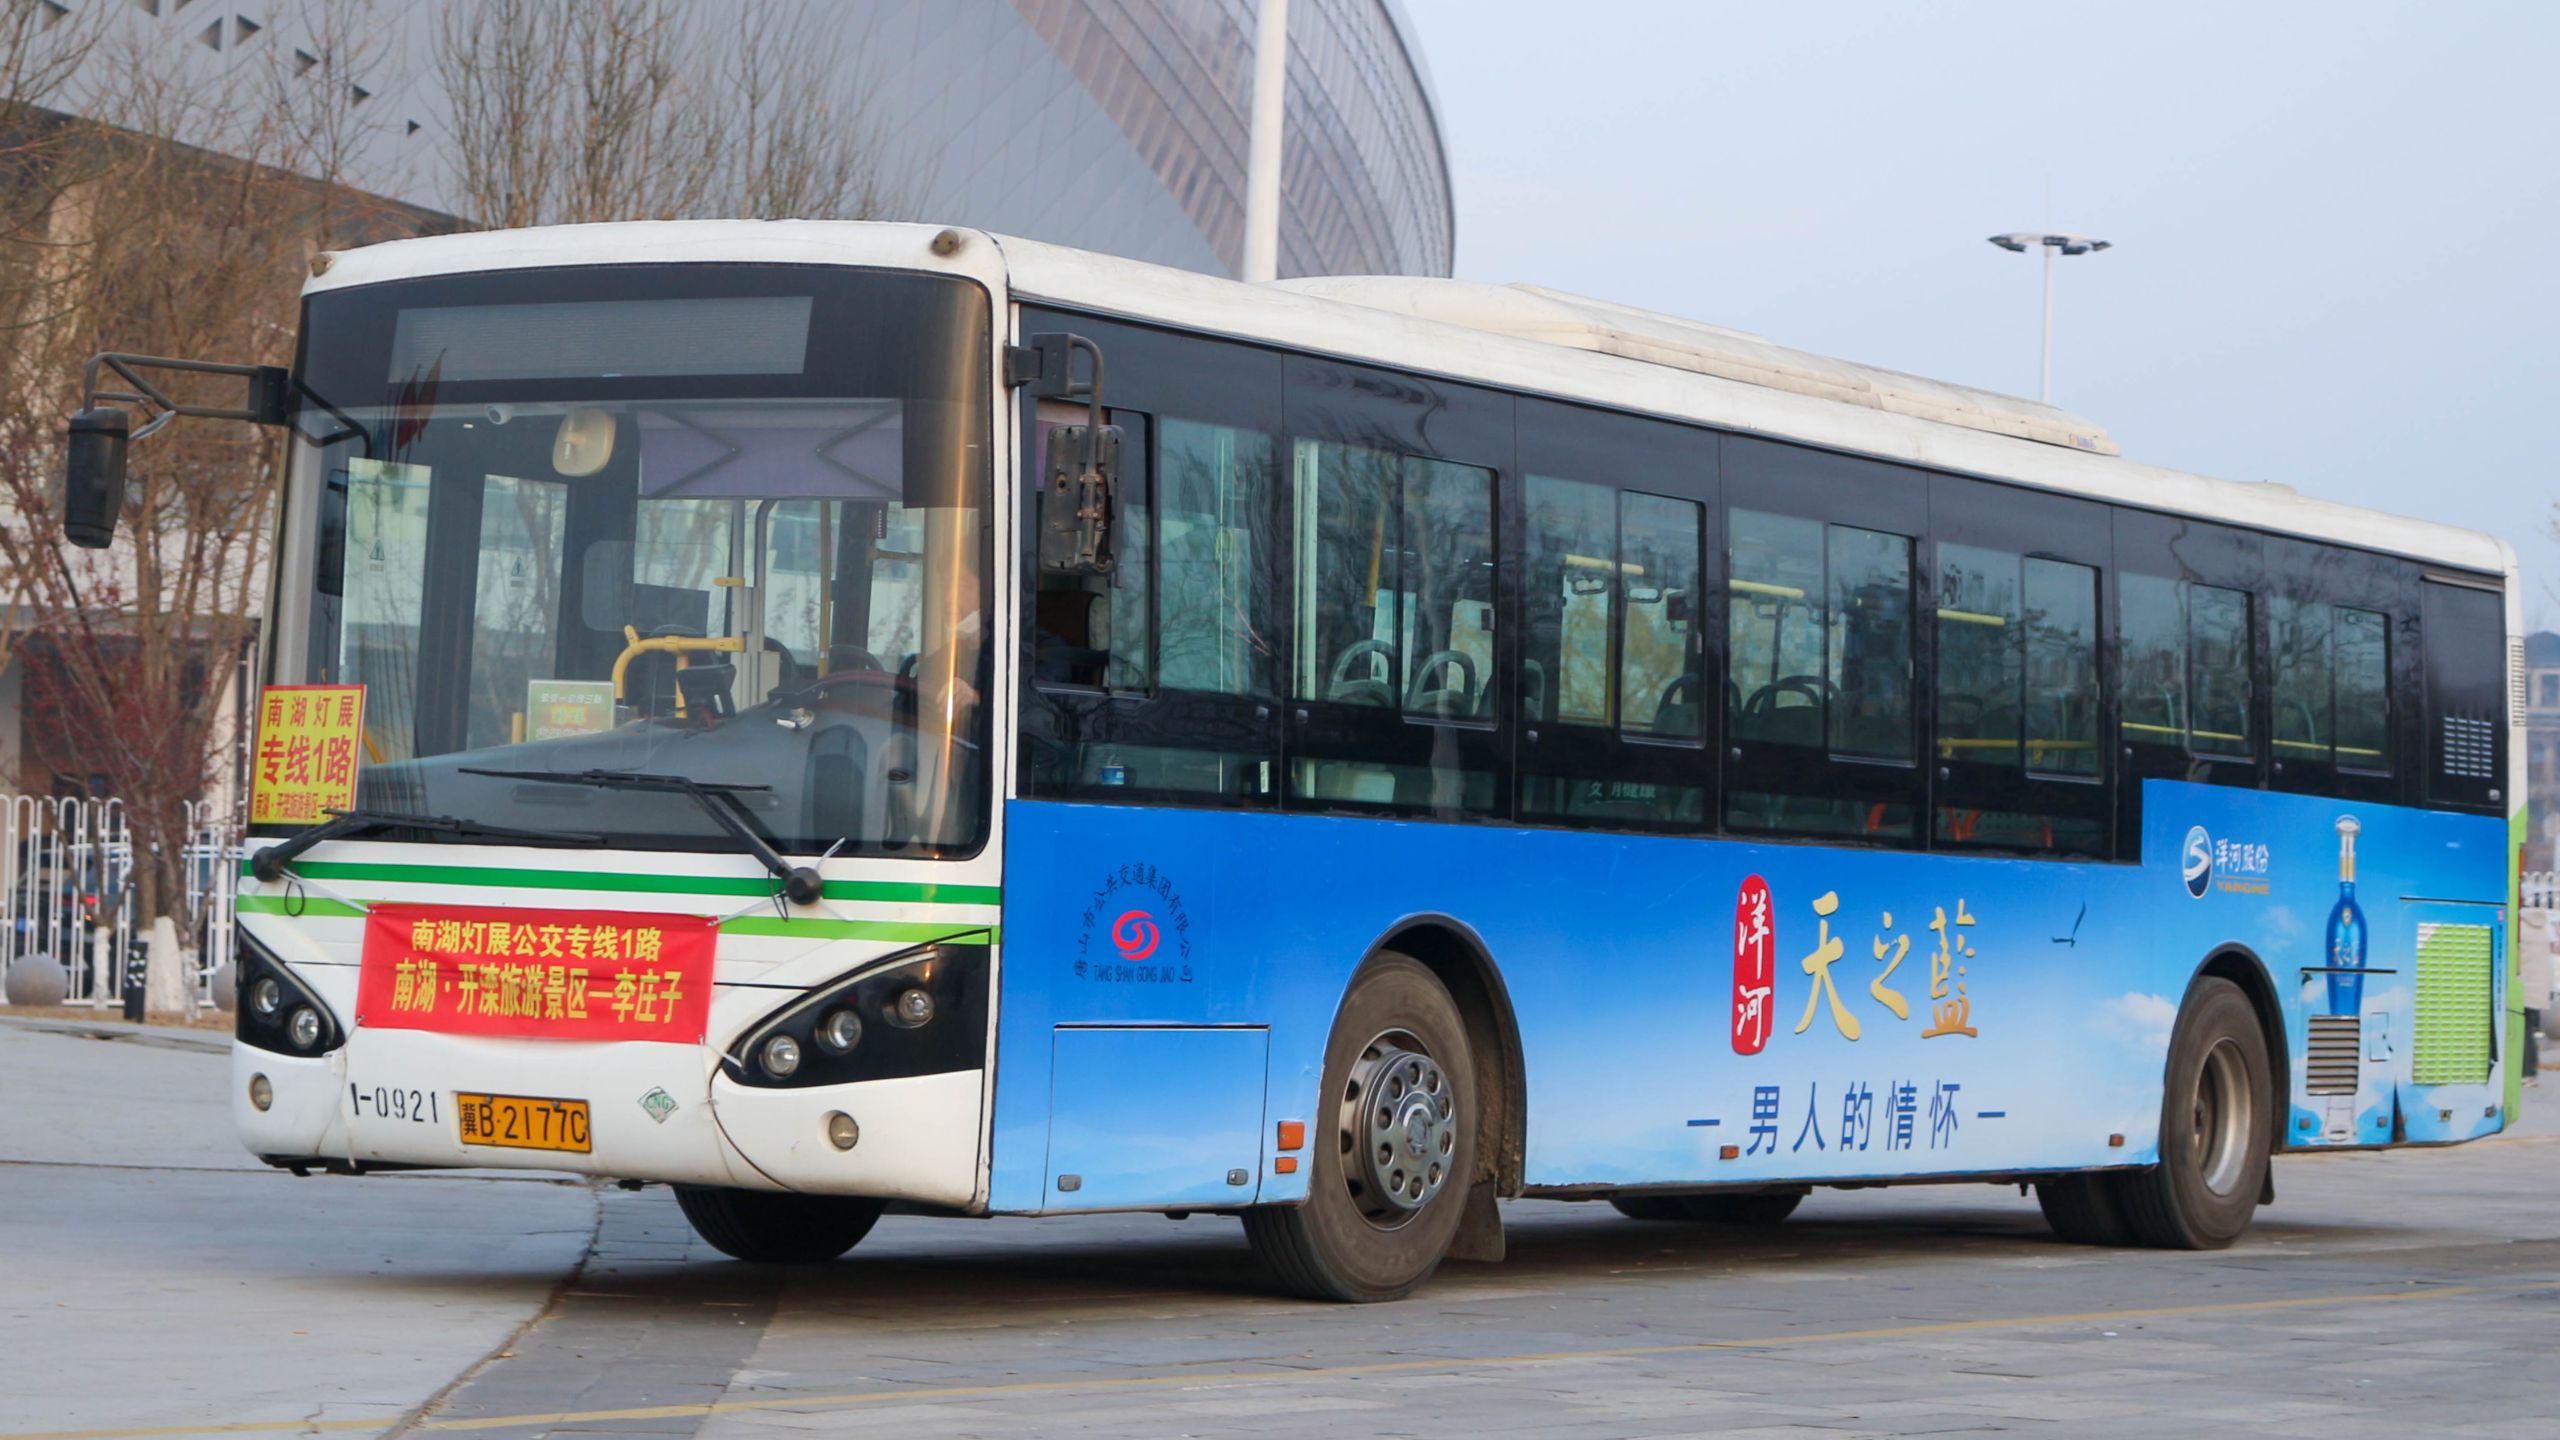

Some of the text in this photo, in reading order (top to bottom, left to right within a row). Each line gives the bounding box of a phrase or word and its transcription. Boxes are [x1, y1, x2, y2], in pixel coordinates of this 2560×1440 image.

[267, 695, 354, 728] 南湖灯展
[261, 734, 352, 787] 专线1路
[2215, 838, 2270, 876] 洋河股份
[411, 918, 663, 962] 南湖灯展公交专线1路
[1735, 887, 1772, 1048] 洋河
